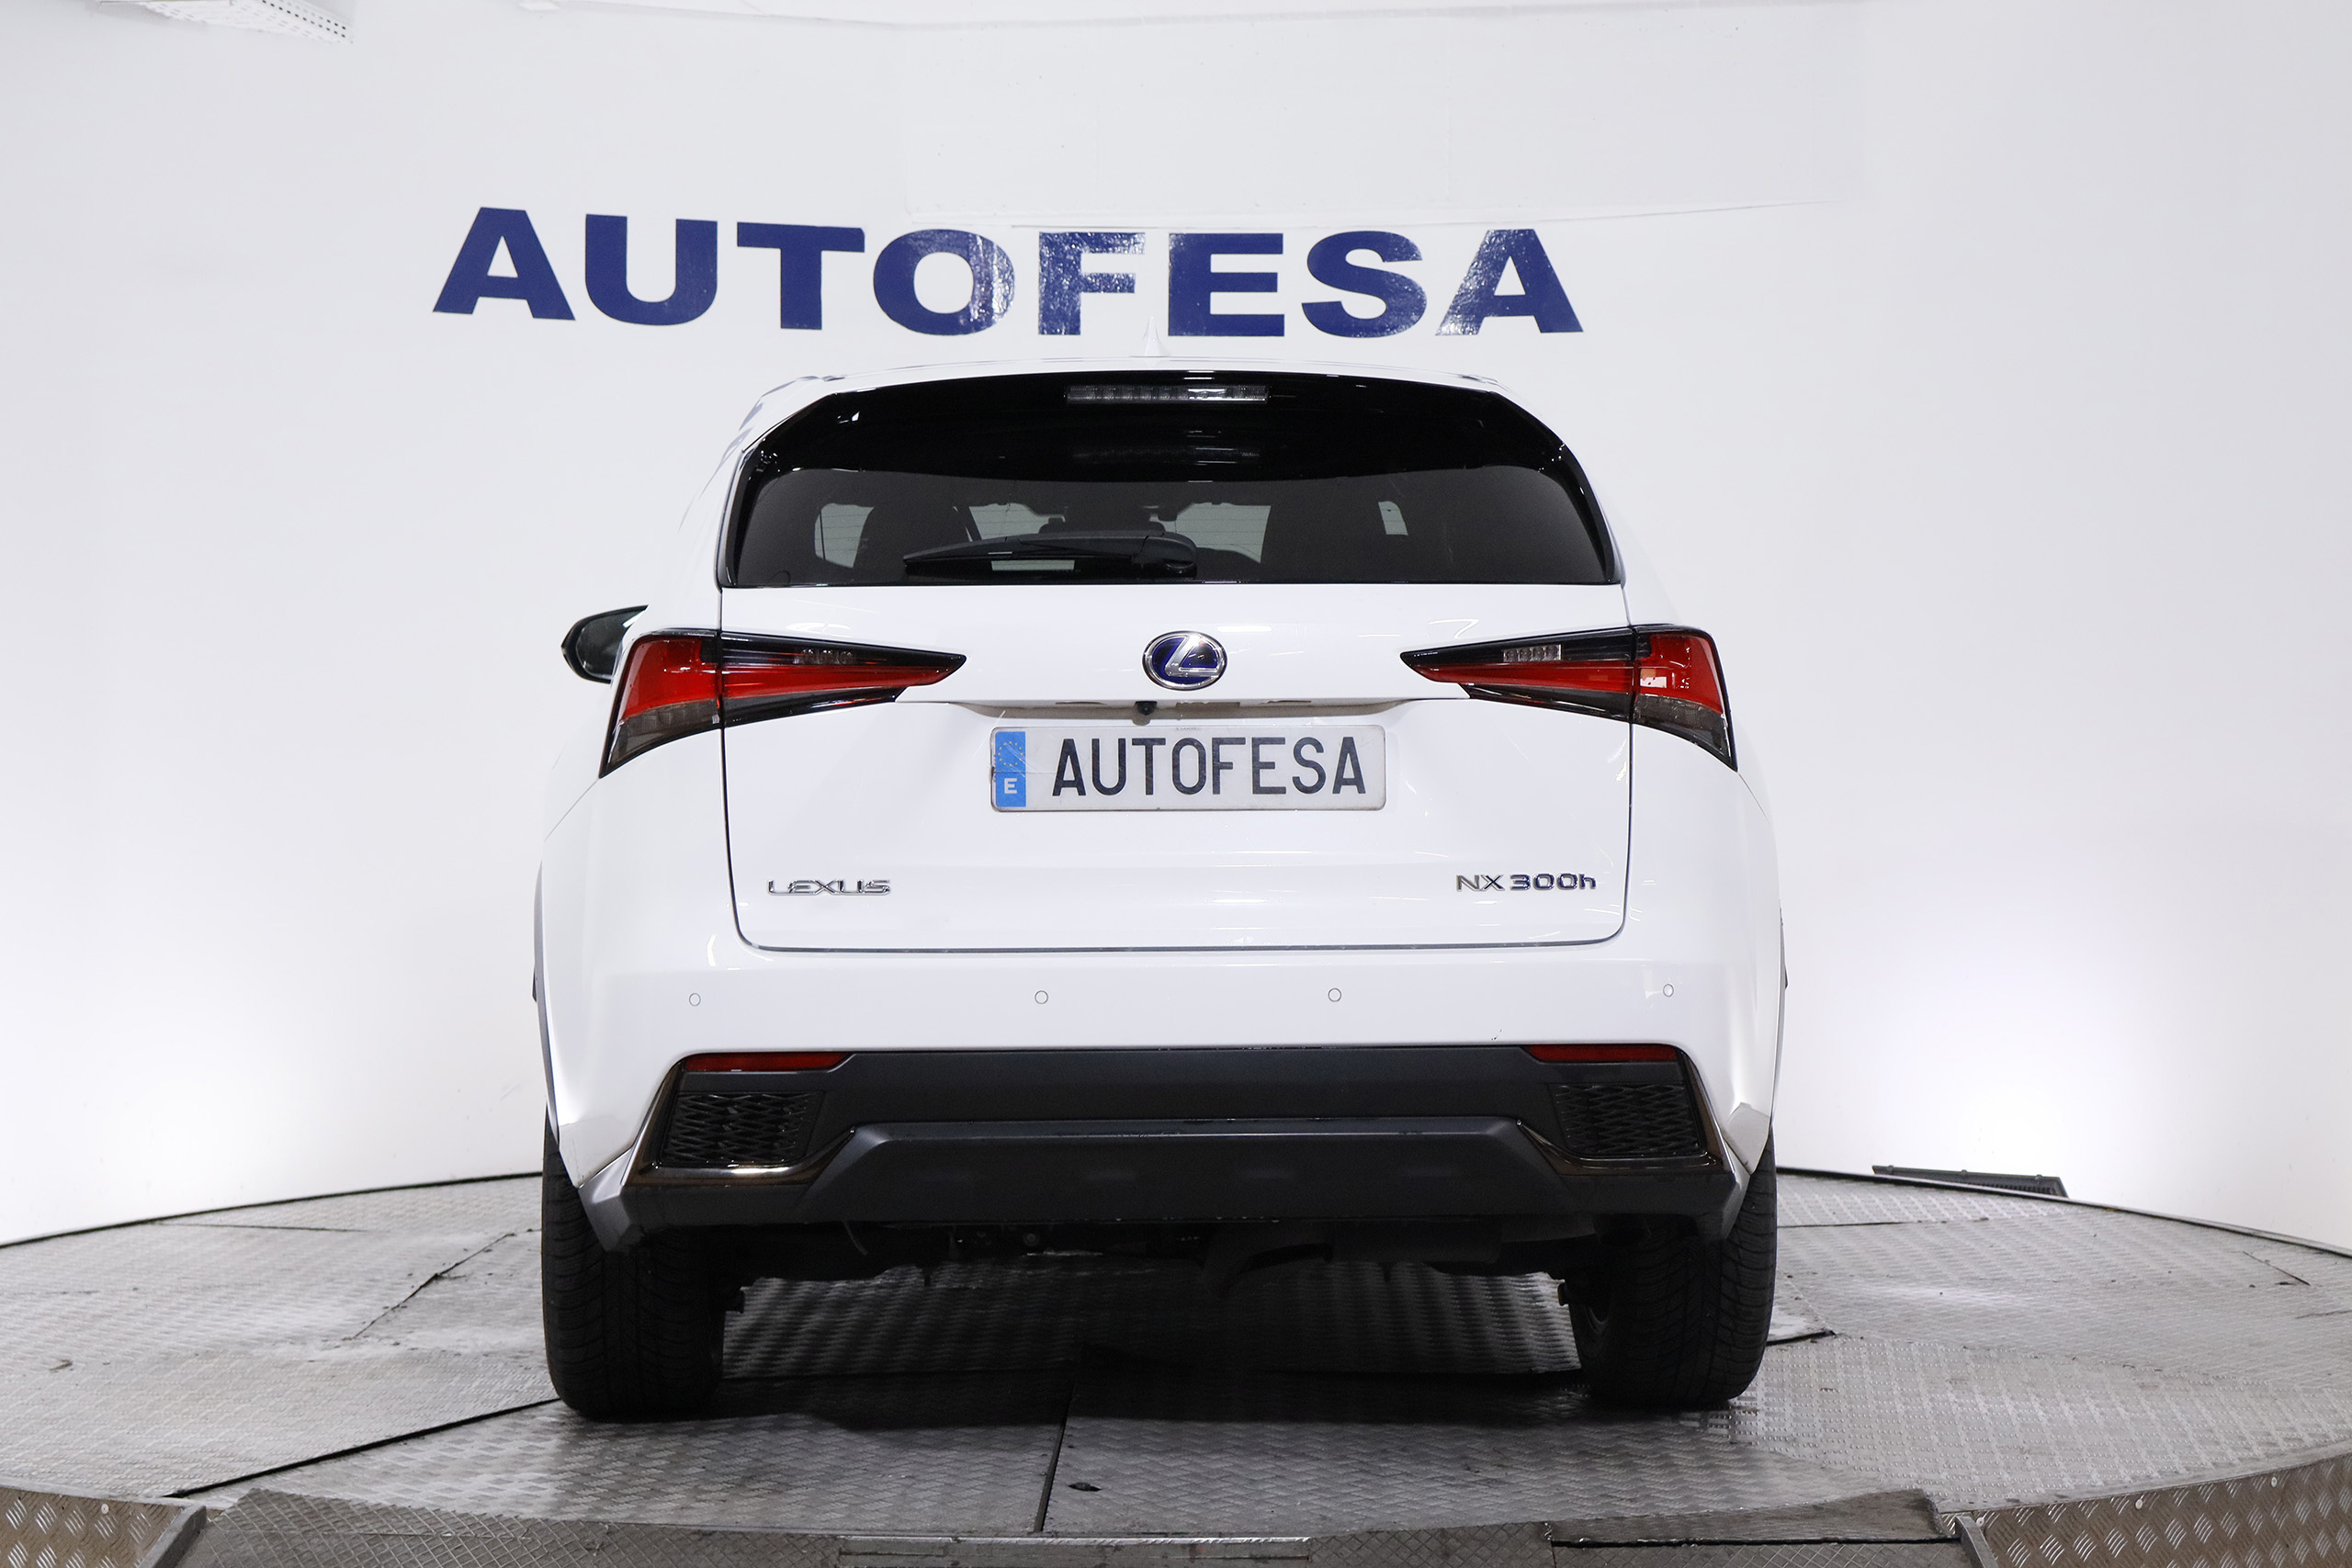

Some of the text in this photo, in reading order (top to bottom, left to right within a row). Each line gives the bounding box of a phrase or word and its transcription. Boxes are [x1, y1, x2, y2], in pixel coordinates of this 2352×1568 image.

[435, 208, 1584, 337] AUTOFESA
[1051, 736, 1367, 796] AUTOFESA
[1004, 778, 1018, 794] E
[767, 879, 891, 896] LEXUS
[1456, 873, 1597, 892] NX 300h
